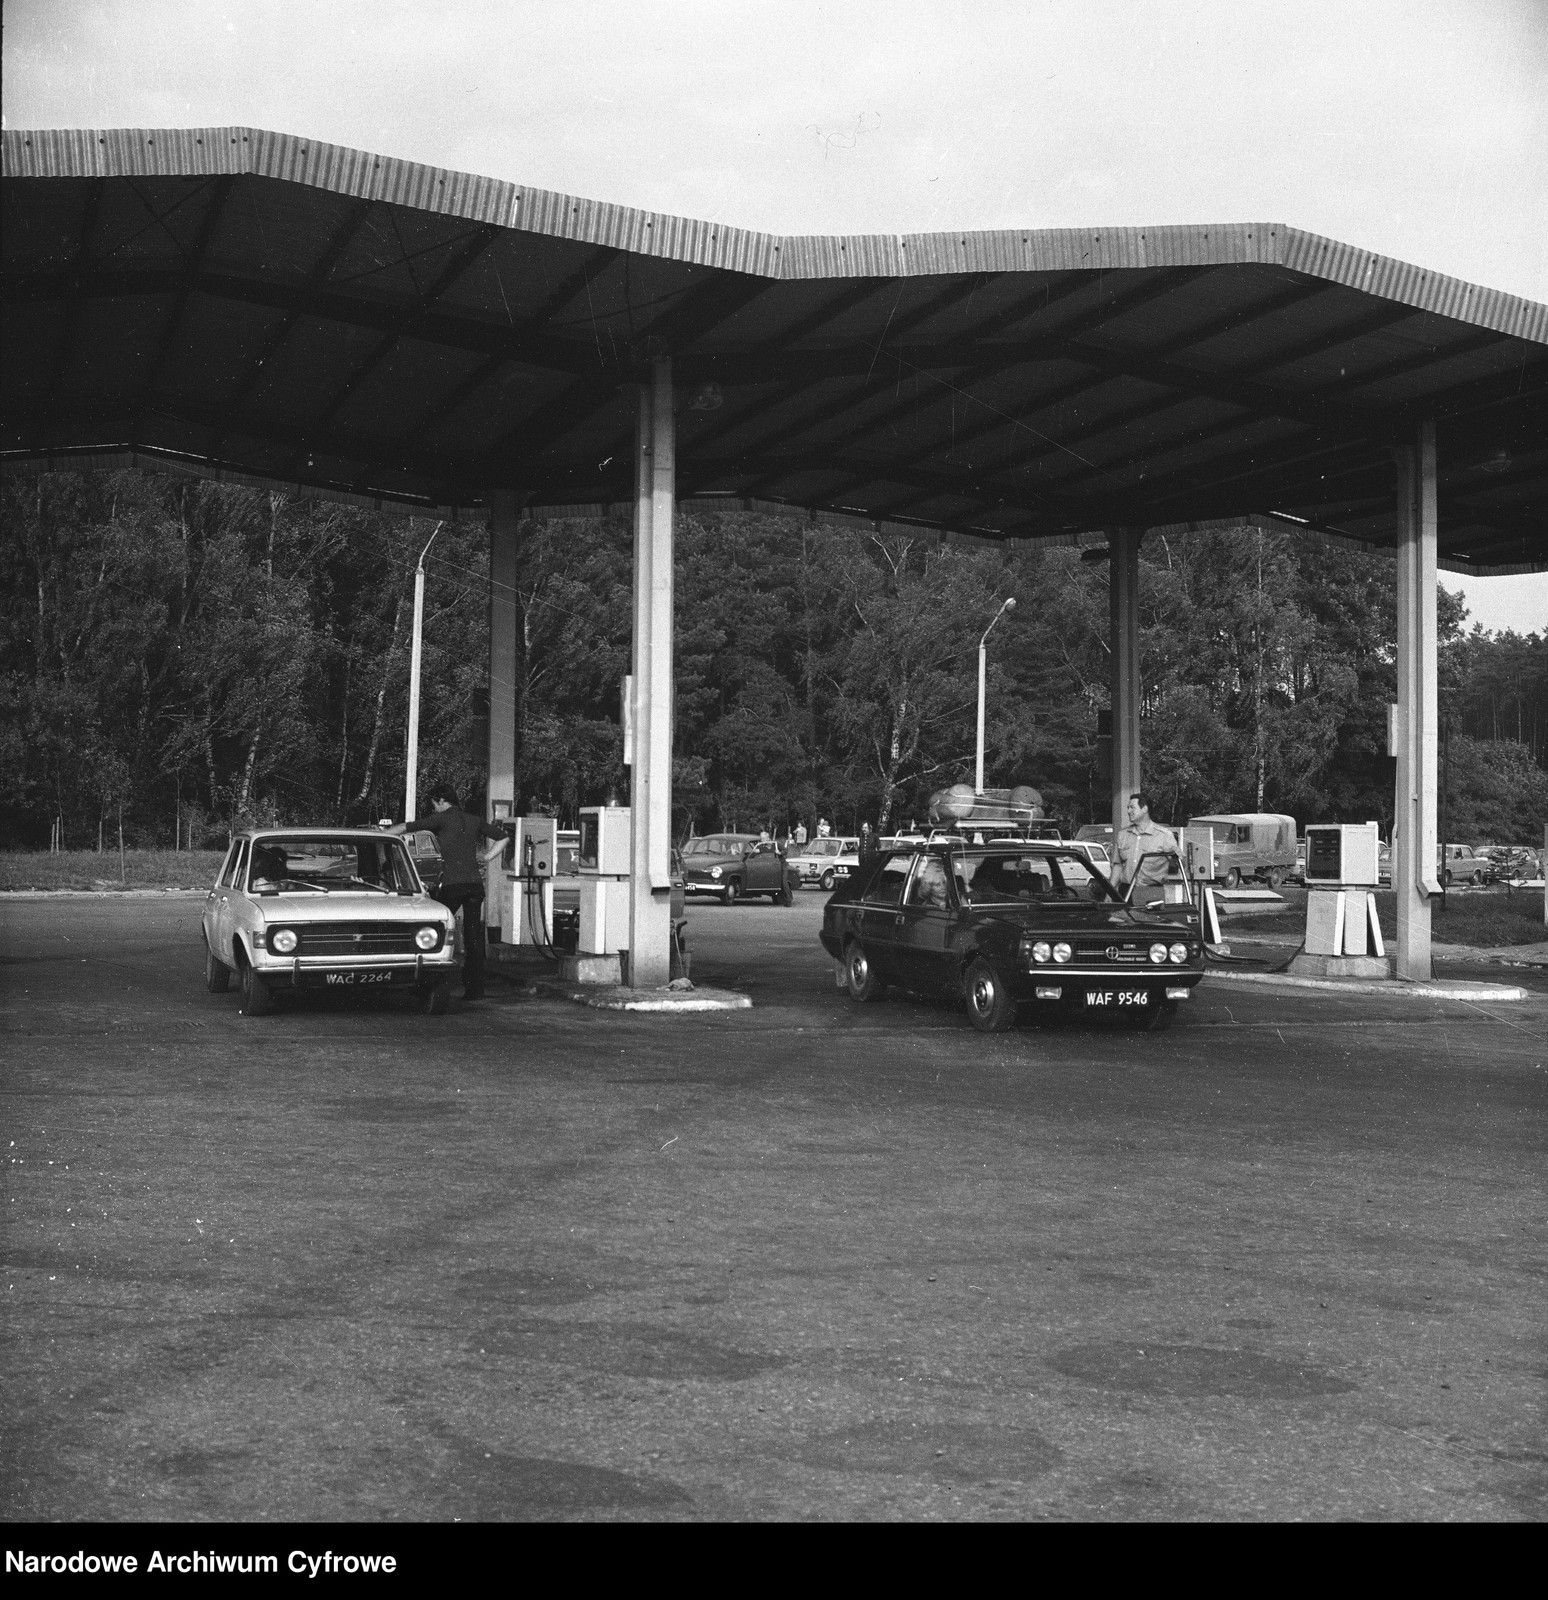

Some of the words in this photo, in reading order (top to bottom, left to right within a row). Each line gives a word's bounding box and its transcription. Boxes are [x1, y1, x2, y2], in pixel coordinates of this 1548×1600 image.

[360, 971, 392, 983] 2264
[1086, 992, 1114, 1005] WAF
[1118, 992, 1148, 1005] 9546
